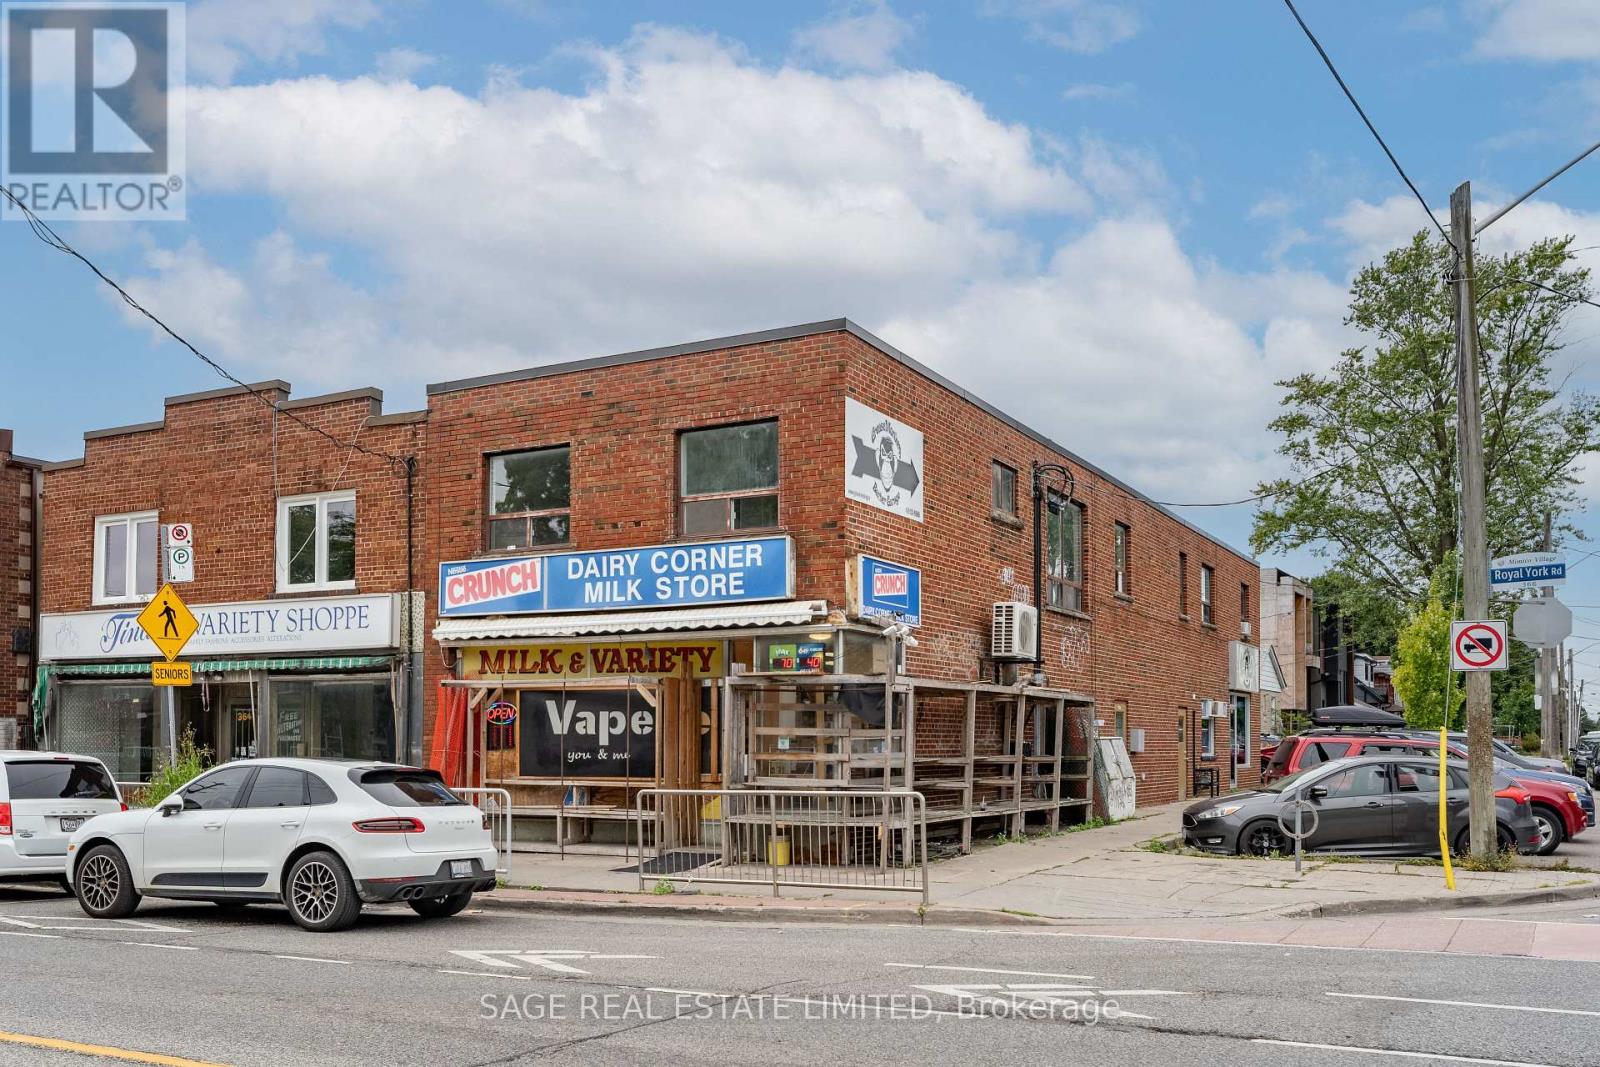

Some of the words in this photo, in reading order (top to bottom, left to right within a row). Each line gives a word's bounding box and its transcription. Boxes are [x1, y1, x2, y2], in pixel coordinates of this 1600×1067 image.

[567, 553, 640, 580] DAIRY
[650, 543, 764, 574] CORNER
[447, 560, 538, 605] CRUNCH
[1494, 568, 1524, 582] Royal
[1525, 566, 1549, 578] York
[1551, 566, 1562, 576] Rd
[584, 578, 643, 604] MILK
[656, 572, 745, 601] STORE
[874, 574, 906, 594] CRUNCH
[193, 609, 280, 635] VARIETY
[286, 605, 370, 633] SHOPPE
[904, 613, 919, 625] STORE
[478, 648, 564, 675] MILK
[569, 651, 586, 674] &
[590, 646, 717, 674] VARIETY
[781, 657, 793, 668] 70
[807, 657, 820, 668] 40
[155, 668, 189, 680] SENIORS
[487, 706, 515, 720] OPEN
[545, 699, 654, 746] Vape
[567, 751, 592, 763] you
[597, 748, 608, 760] &
